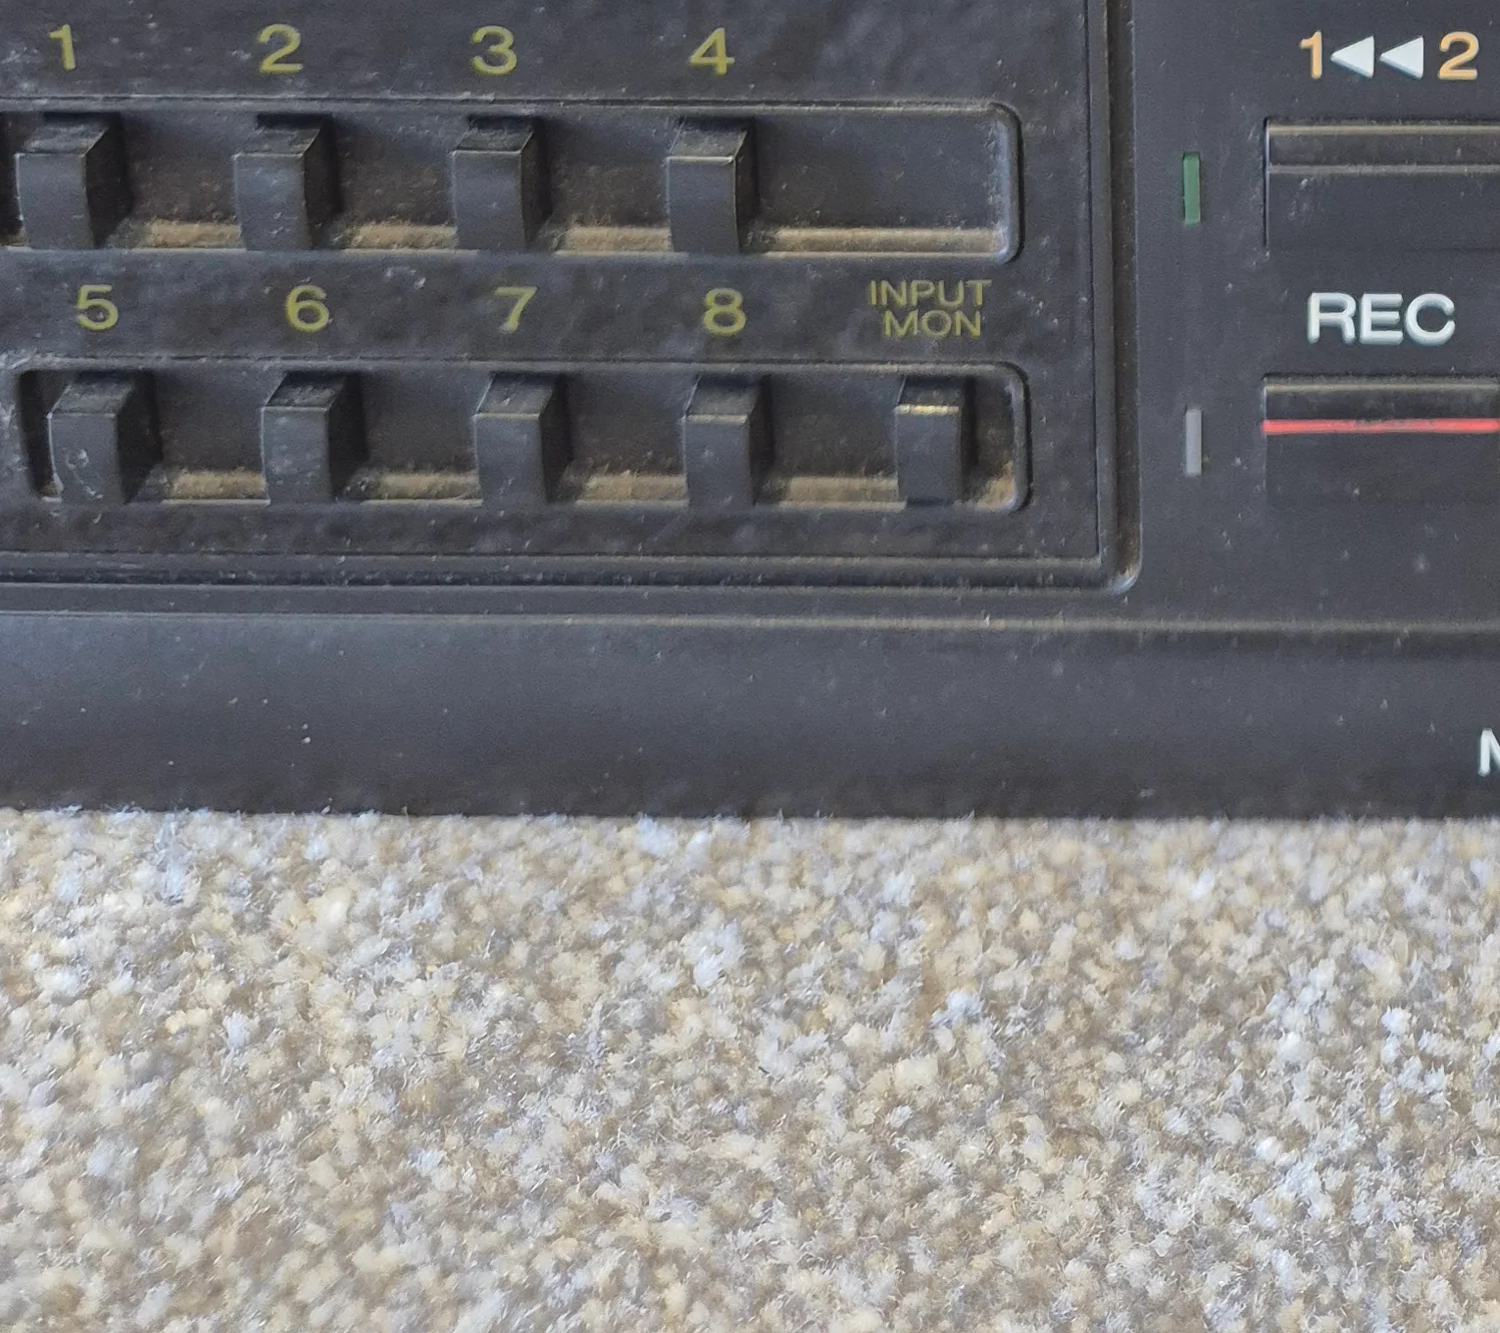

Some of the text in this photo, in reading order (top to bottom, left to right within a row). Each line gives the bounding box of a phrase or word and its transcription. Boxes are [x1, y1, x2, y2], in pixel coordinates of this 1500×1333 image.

[50, 23, 77, 72] 1
[256, 23, 303, 74] 2
[470, 25, 518, 76] 3
[688, 26, 736, 77] 4
[1299, 31, 1480, 82] 1 2
[75, 284, 120, 332] 5
[284, 285, 331, 333] 6
[494, 285, 539, 333] 7
[702, 286, 749, 336] 8
[868, 279, 992, 307] INPUT
[882, 308, 982, 339] MON
[1306, 291, 1457, 345] REC
